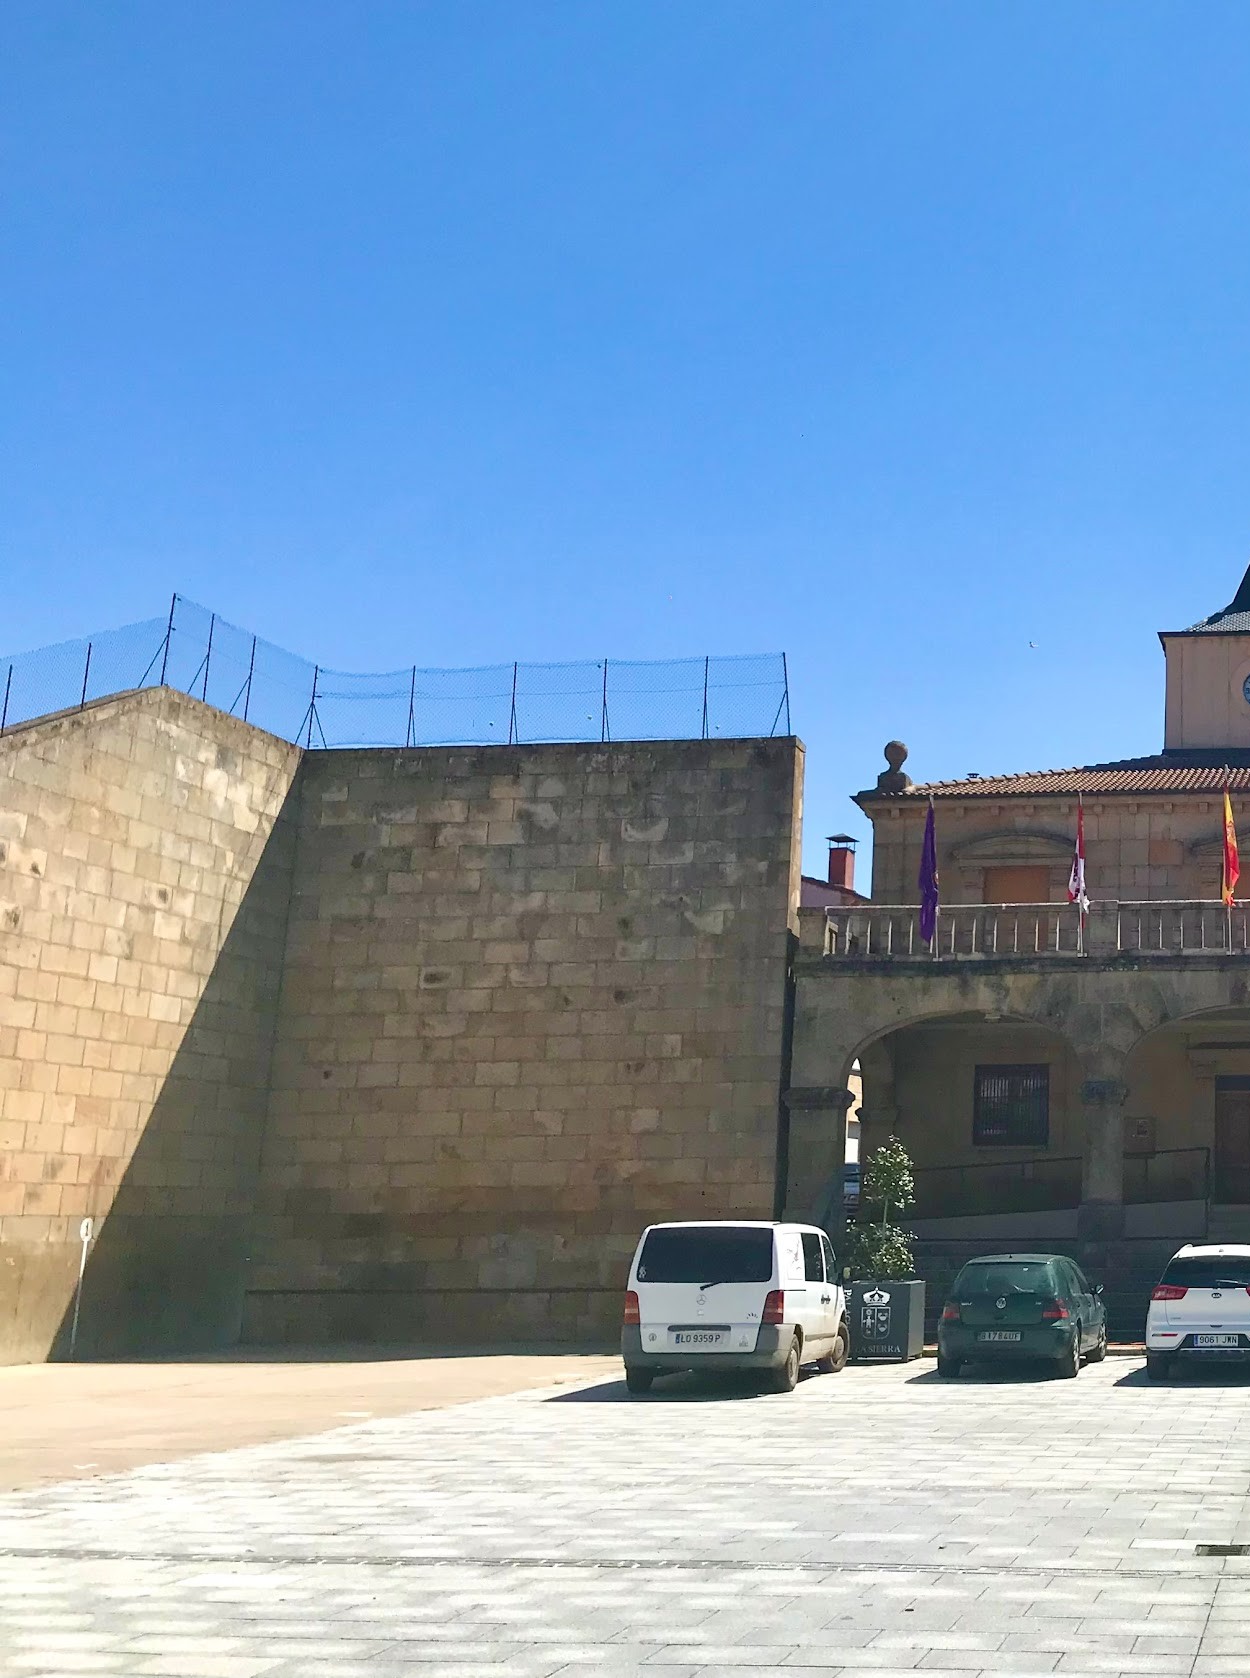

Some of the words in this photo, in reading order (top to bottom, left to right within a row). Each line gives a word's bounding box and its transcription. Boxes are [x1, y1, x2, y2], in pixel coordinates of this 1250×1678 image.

[693, 1334, 714, 1343] 9359
[714, 1334, 721, 1343] P
[1199, 1336, 1219, 1344] 9061
[867, 1344, 902, 1353] SIERRA
